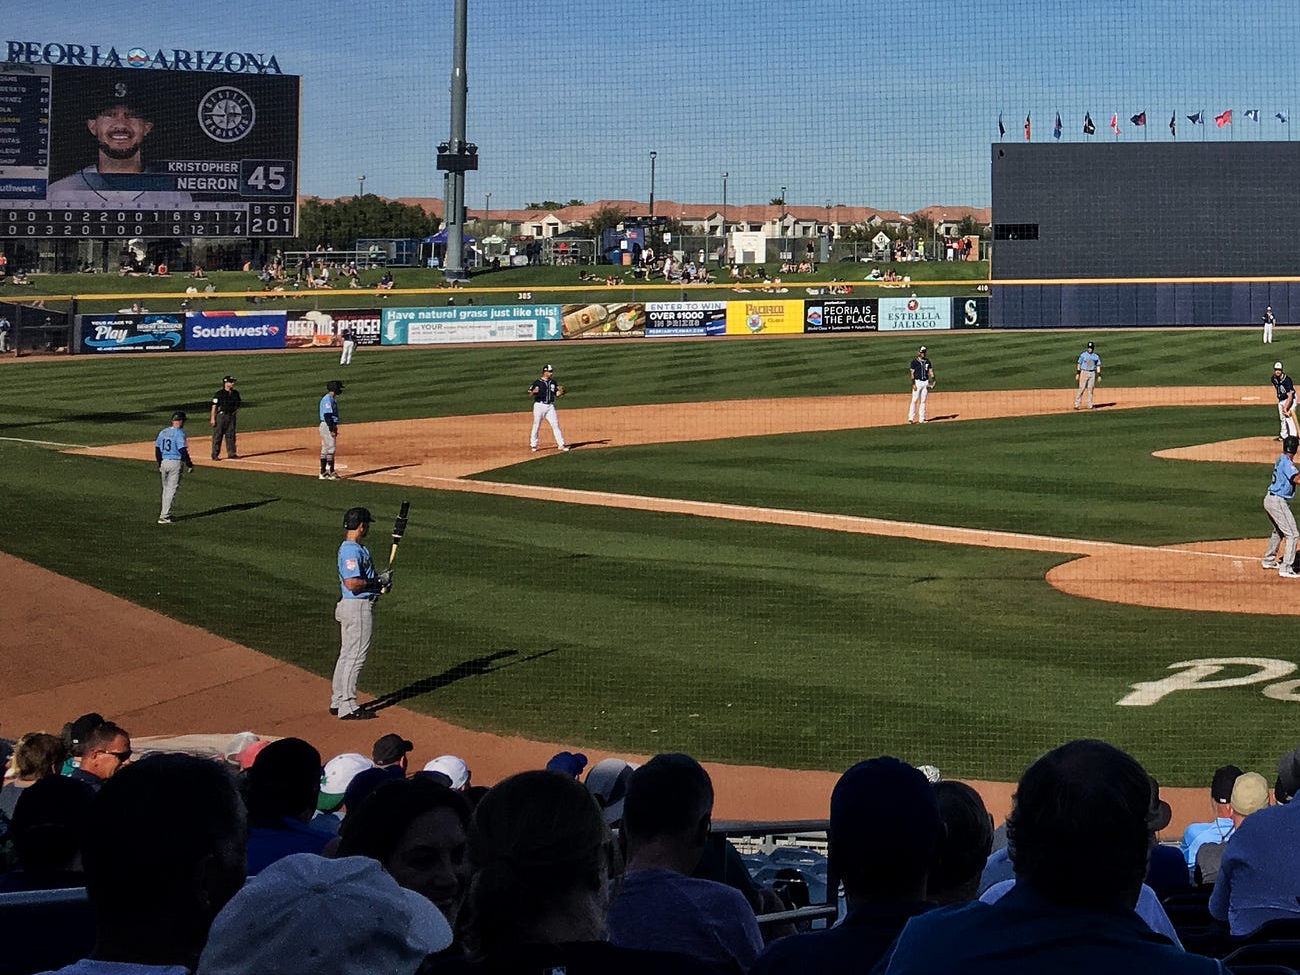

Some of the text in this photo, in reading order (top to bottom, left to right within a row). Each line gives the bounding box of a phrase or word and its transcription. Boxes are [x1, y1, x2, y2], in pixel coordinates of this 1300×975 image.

[6, 40, 283, 74] PEORIA ARIZONA
[115, 82, 126, 97] S
[168, 162, 286, 190] KRISTOPHER 45
[177, 177, 238, 190] NEGRON
[9, 212, 241, 221] 0 0 1 0 2 2 0 0 1 6 9 1 7
[253, 206, 261, 214] B
[269, 206, 276, 214] S
[9, 225, 241, 234] 0 0 3 2 0 1 0 0 6 12 1 4
[252, 219, 290, 232] 2 0 1
[387, 307, 558, 322] Have natural grass just like this!
[650, 311, 704, 320] OVER $1000
[824, 306, 871, 315] PEORIA IS
[964, 299, 978, 325] S
[824, 315, 877, 324] THE PLACE
[892, 321, 937, 329] JALISCO
[95, 326, 128, 343] Play
[192, 325, 268, 337] Southwest
[287, 320, 314, 336] BEER
[162, 438, 172, 452] 13
